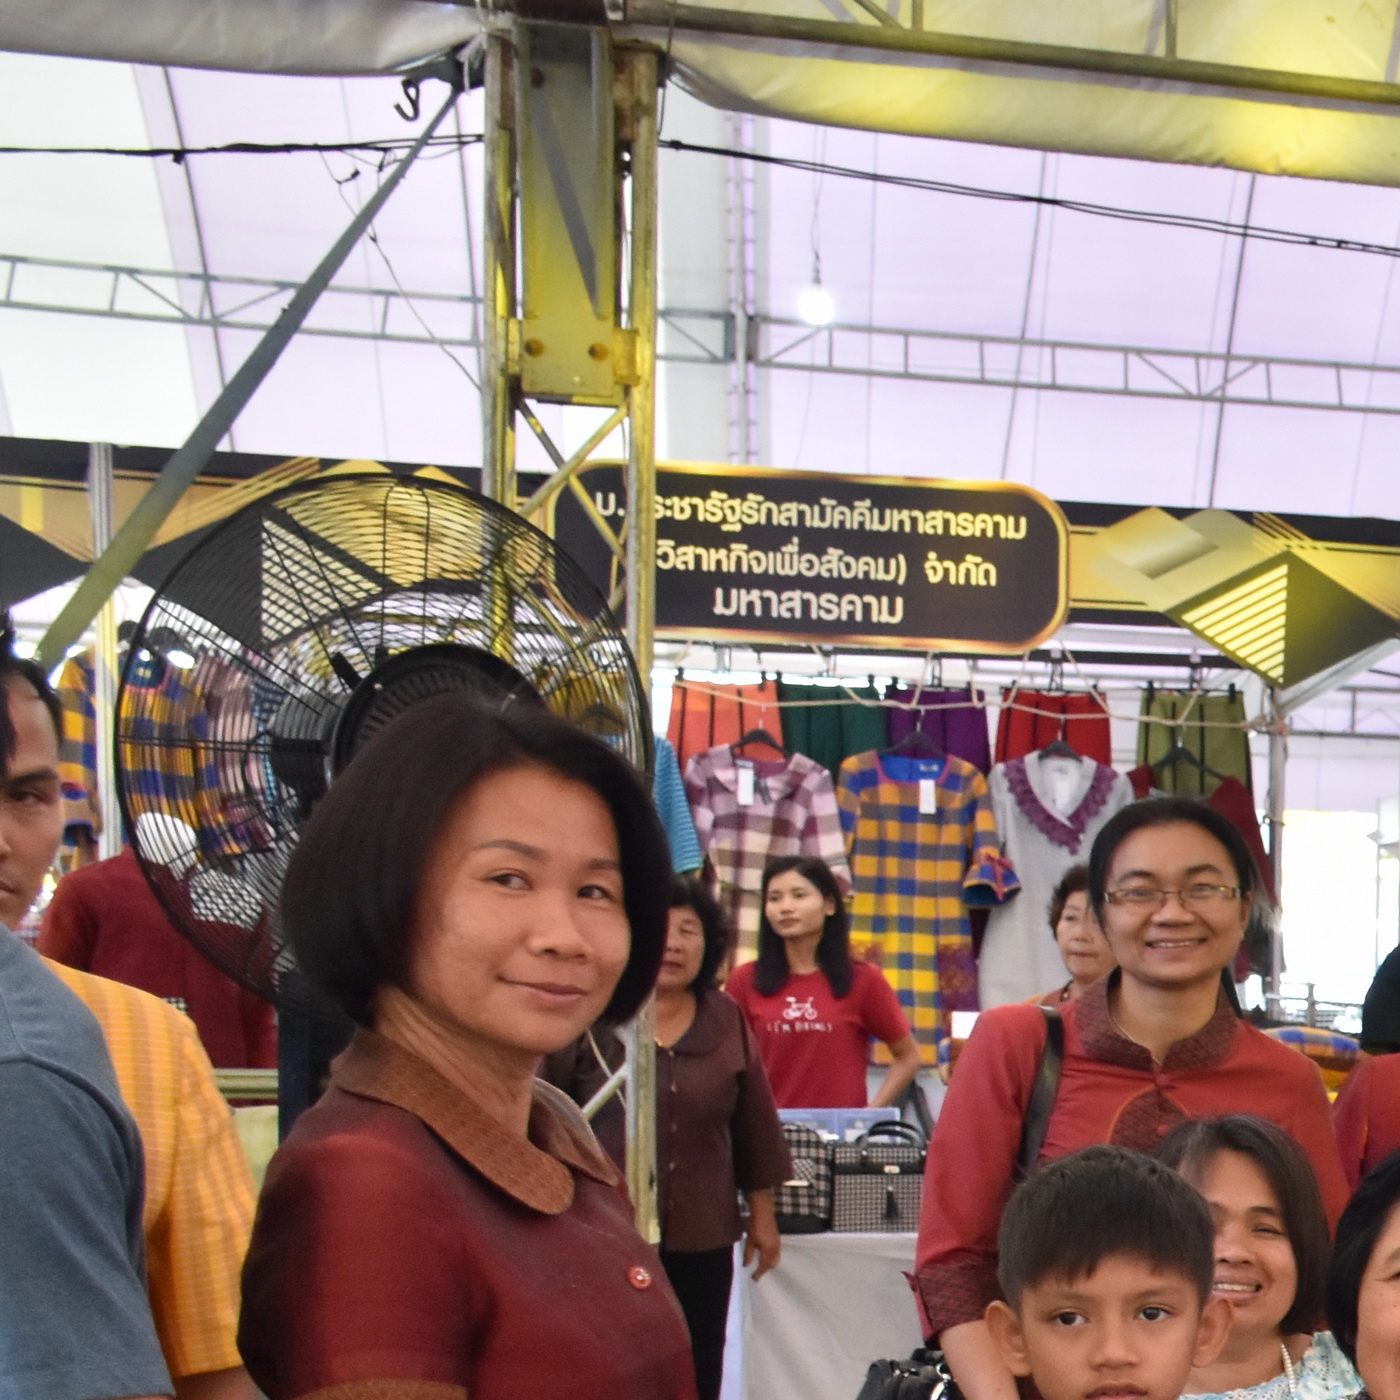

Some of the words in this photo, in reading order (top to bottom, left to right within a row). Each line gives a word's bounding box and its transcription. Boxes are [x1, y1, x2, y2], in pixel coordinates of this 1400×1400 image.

[596, 491, 1028, 541] บ.ระชารัฐรักสามัคคีมหาสารคาม
[655, 537, 908, 586] วิสาหกิจเพื่อสังคม)
[923, 550, 997, 588] จำกัด
[712, 587, 904, 625] มหาสารคาม
